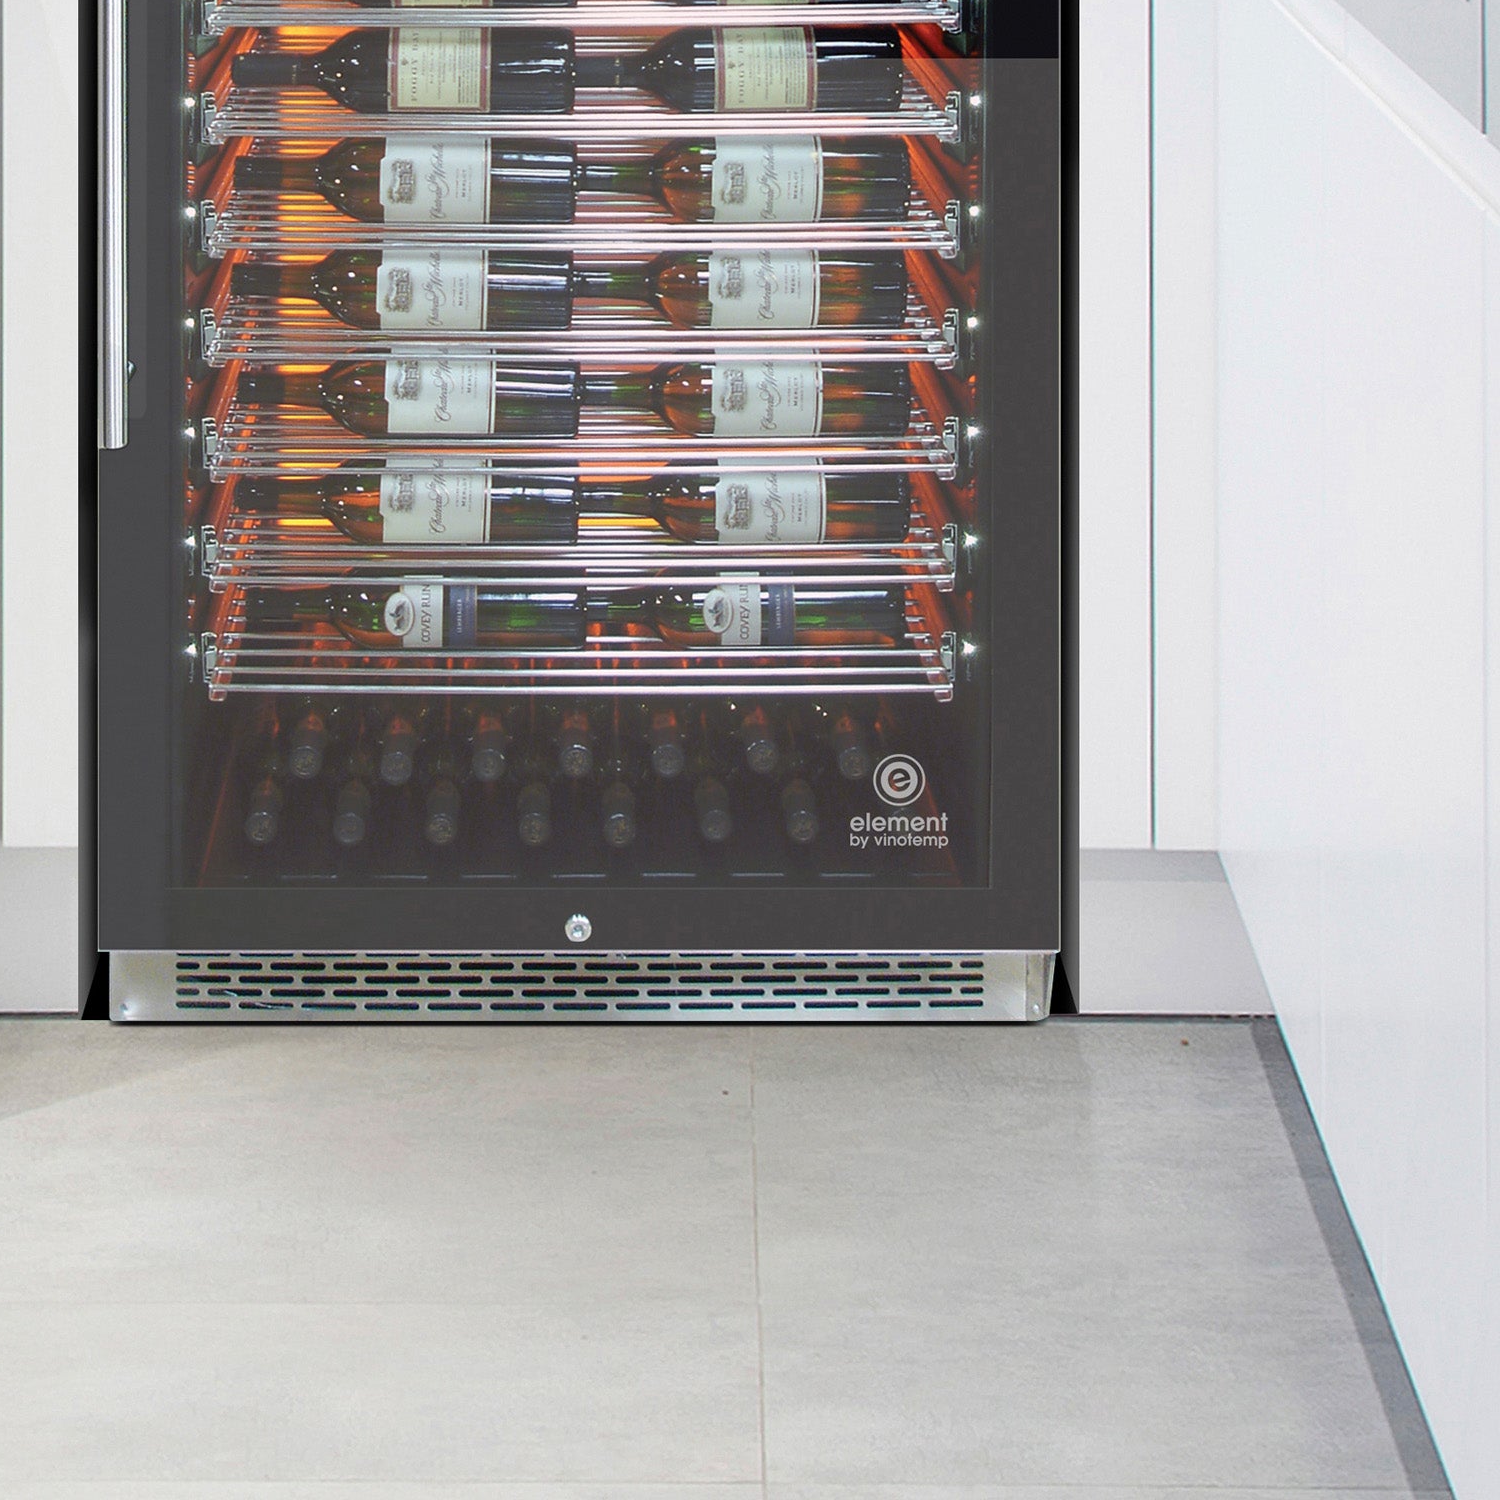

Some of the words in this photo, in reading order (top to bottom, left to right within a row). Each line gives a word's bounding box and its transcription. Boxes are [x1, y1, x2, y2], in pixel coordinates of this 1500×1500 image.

[421, 585, 431, 608] RUN
[420, 610, 432, 643] COVEY
[739, 606, 751, 640] COVEY
[850, 812, 948, 832] element
[850, 833, 869, 849] by
[874, 833, 949, 849] vinotemp
